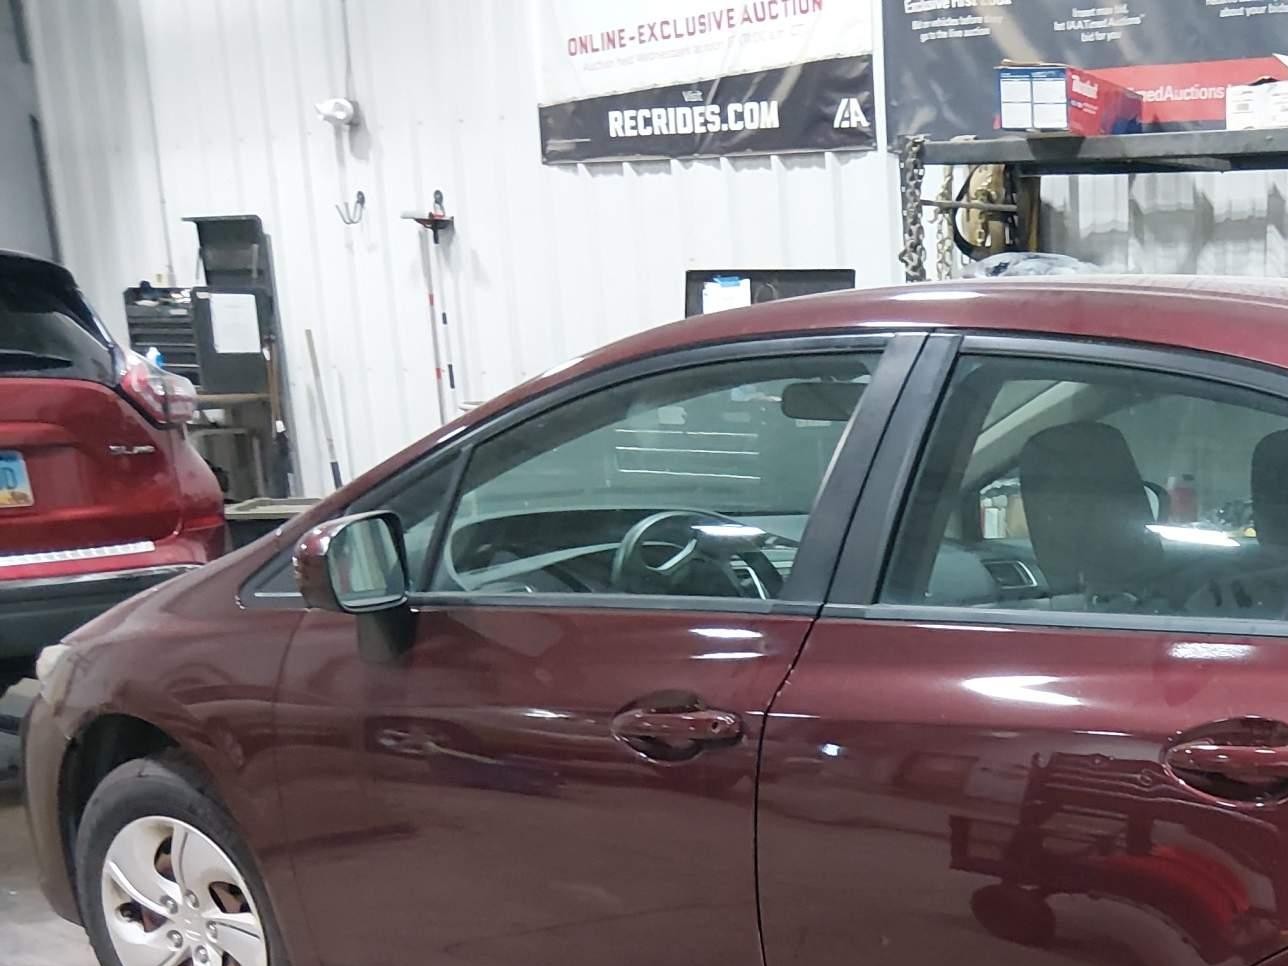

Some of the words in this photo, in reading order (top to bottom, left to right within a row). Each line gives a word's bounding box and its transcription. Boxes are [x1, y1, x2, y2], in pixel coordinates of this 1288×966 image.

[567, 8, 735, 57] ONLINE-EXCLUSIVE
[741, 0, 823, 23] AUCTION
[608, 100, 780, 137] RECRIDES.COM
